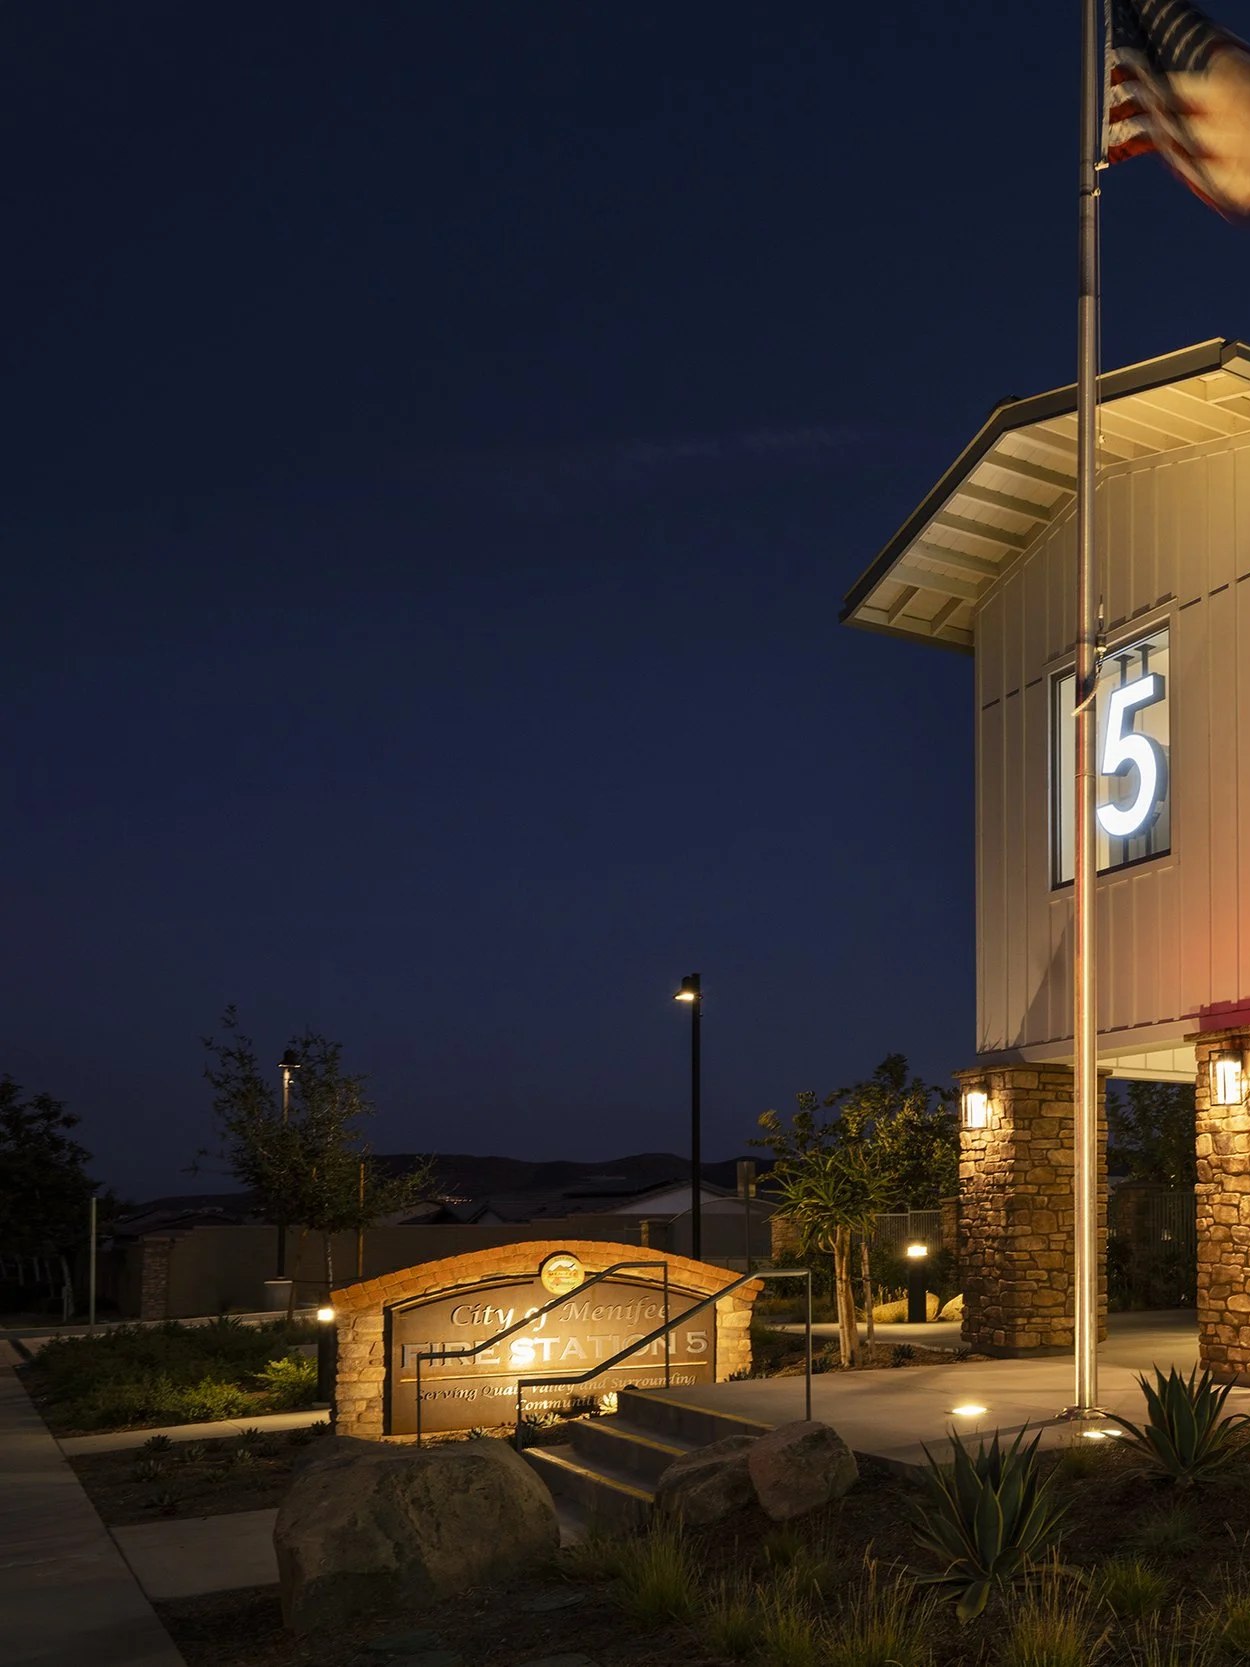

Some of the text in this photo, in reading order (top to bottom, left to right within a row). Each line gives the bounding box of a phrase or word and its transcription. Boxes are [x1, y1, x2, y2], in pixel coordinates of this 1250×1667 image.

[1096, 672, 1166, 838] 5
[451, 1296, 671, 1333] City of Menifee
[401, 1330, 708, 1369] FIRE STATION 5
[481, 1384, 524, 1399] Quai
[515, 1394, 604, 1411] Communitie
